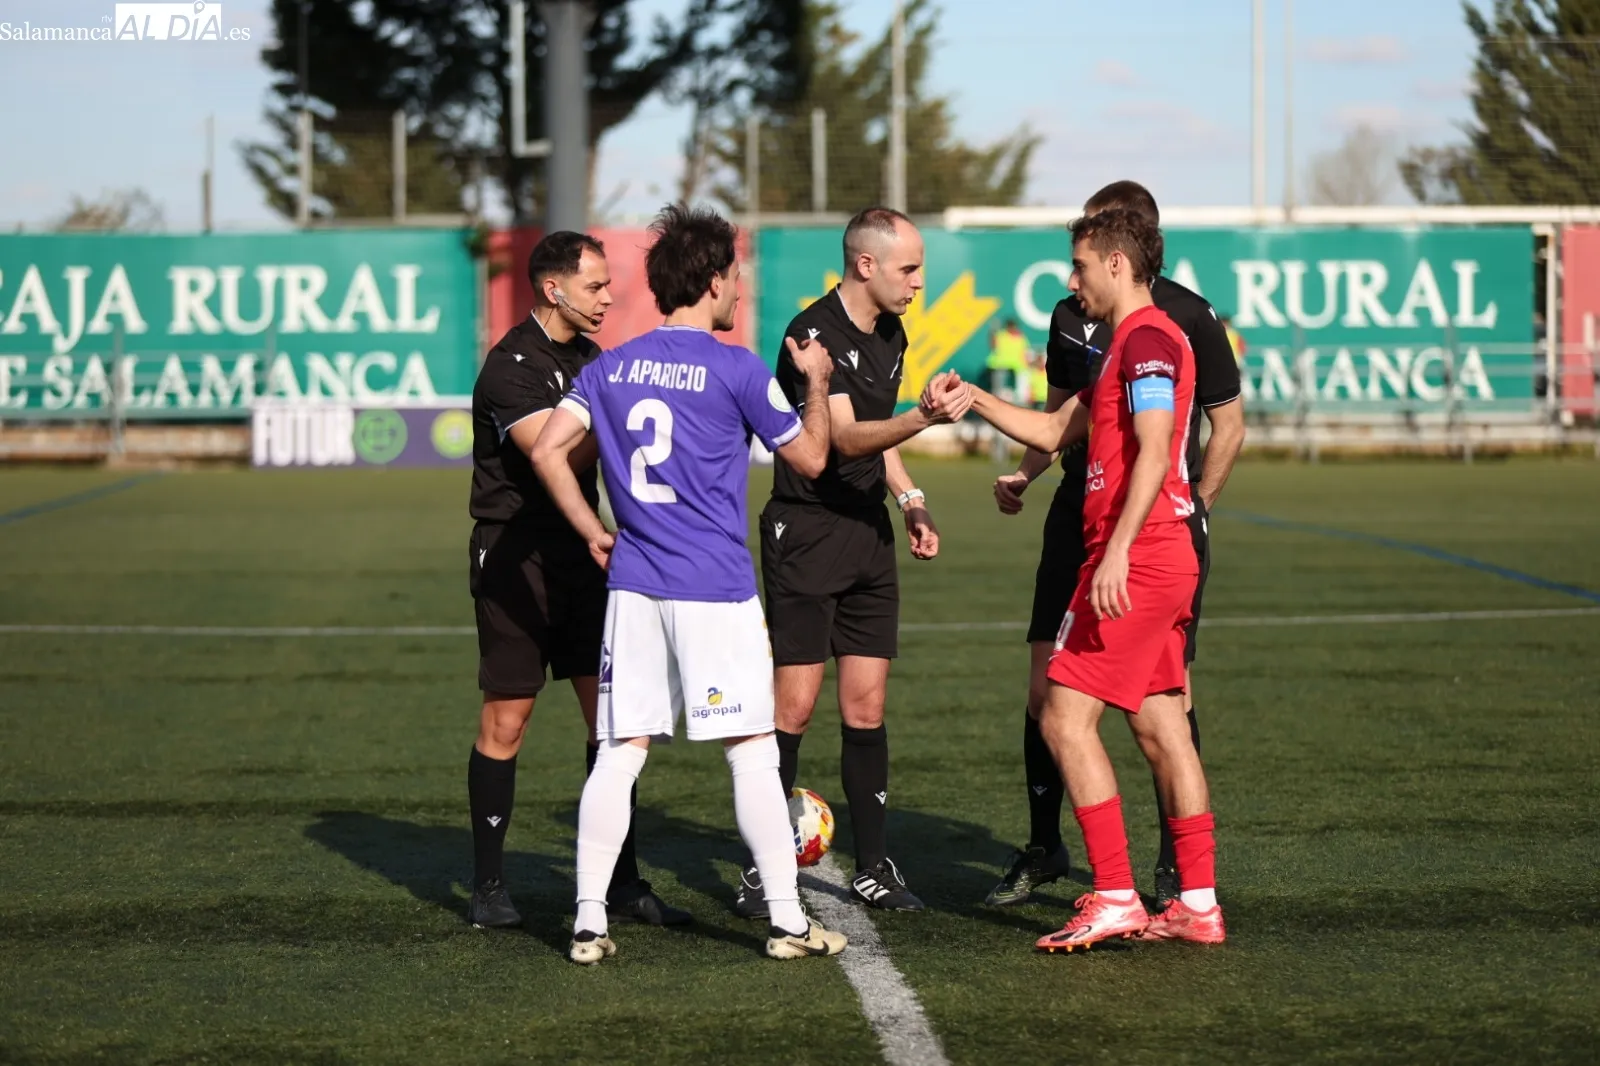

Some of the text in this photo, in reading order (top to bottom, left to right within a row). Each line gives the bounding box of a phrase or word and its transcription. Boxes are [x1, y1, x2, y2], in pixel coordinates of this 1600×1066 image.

[0, 263, 441, 353] AJA RURAL
[1232, 257, 1497, 329] RURAL
[42, 353, 438, 409] SALAMANCA
[608, 359, 707, 392] J. APARICIO
[626, 398, 677, 504] 2
[692, 703, 742, 718] agropal
